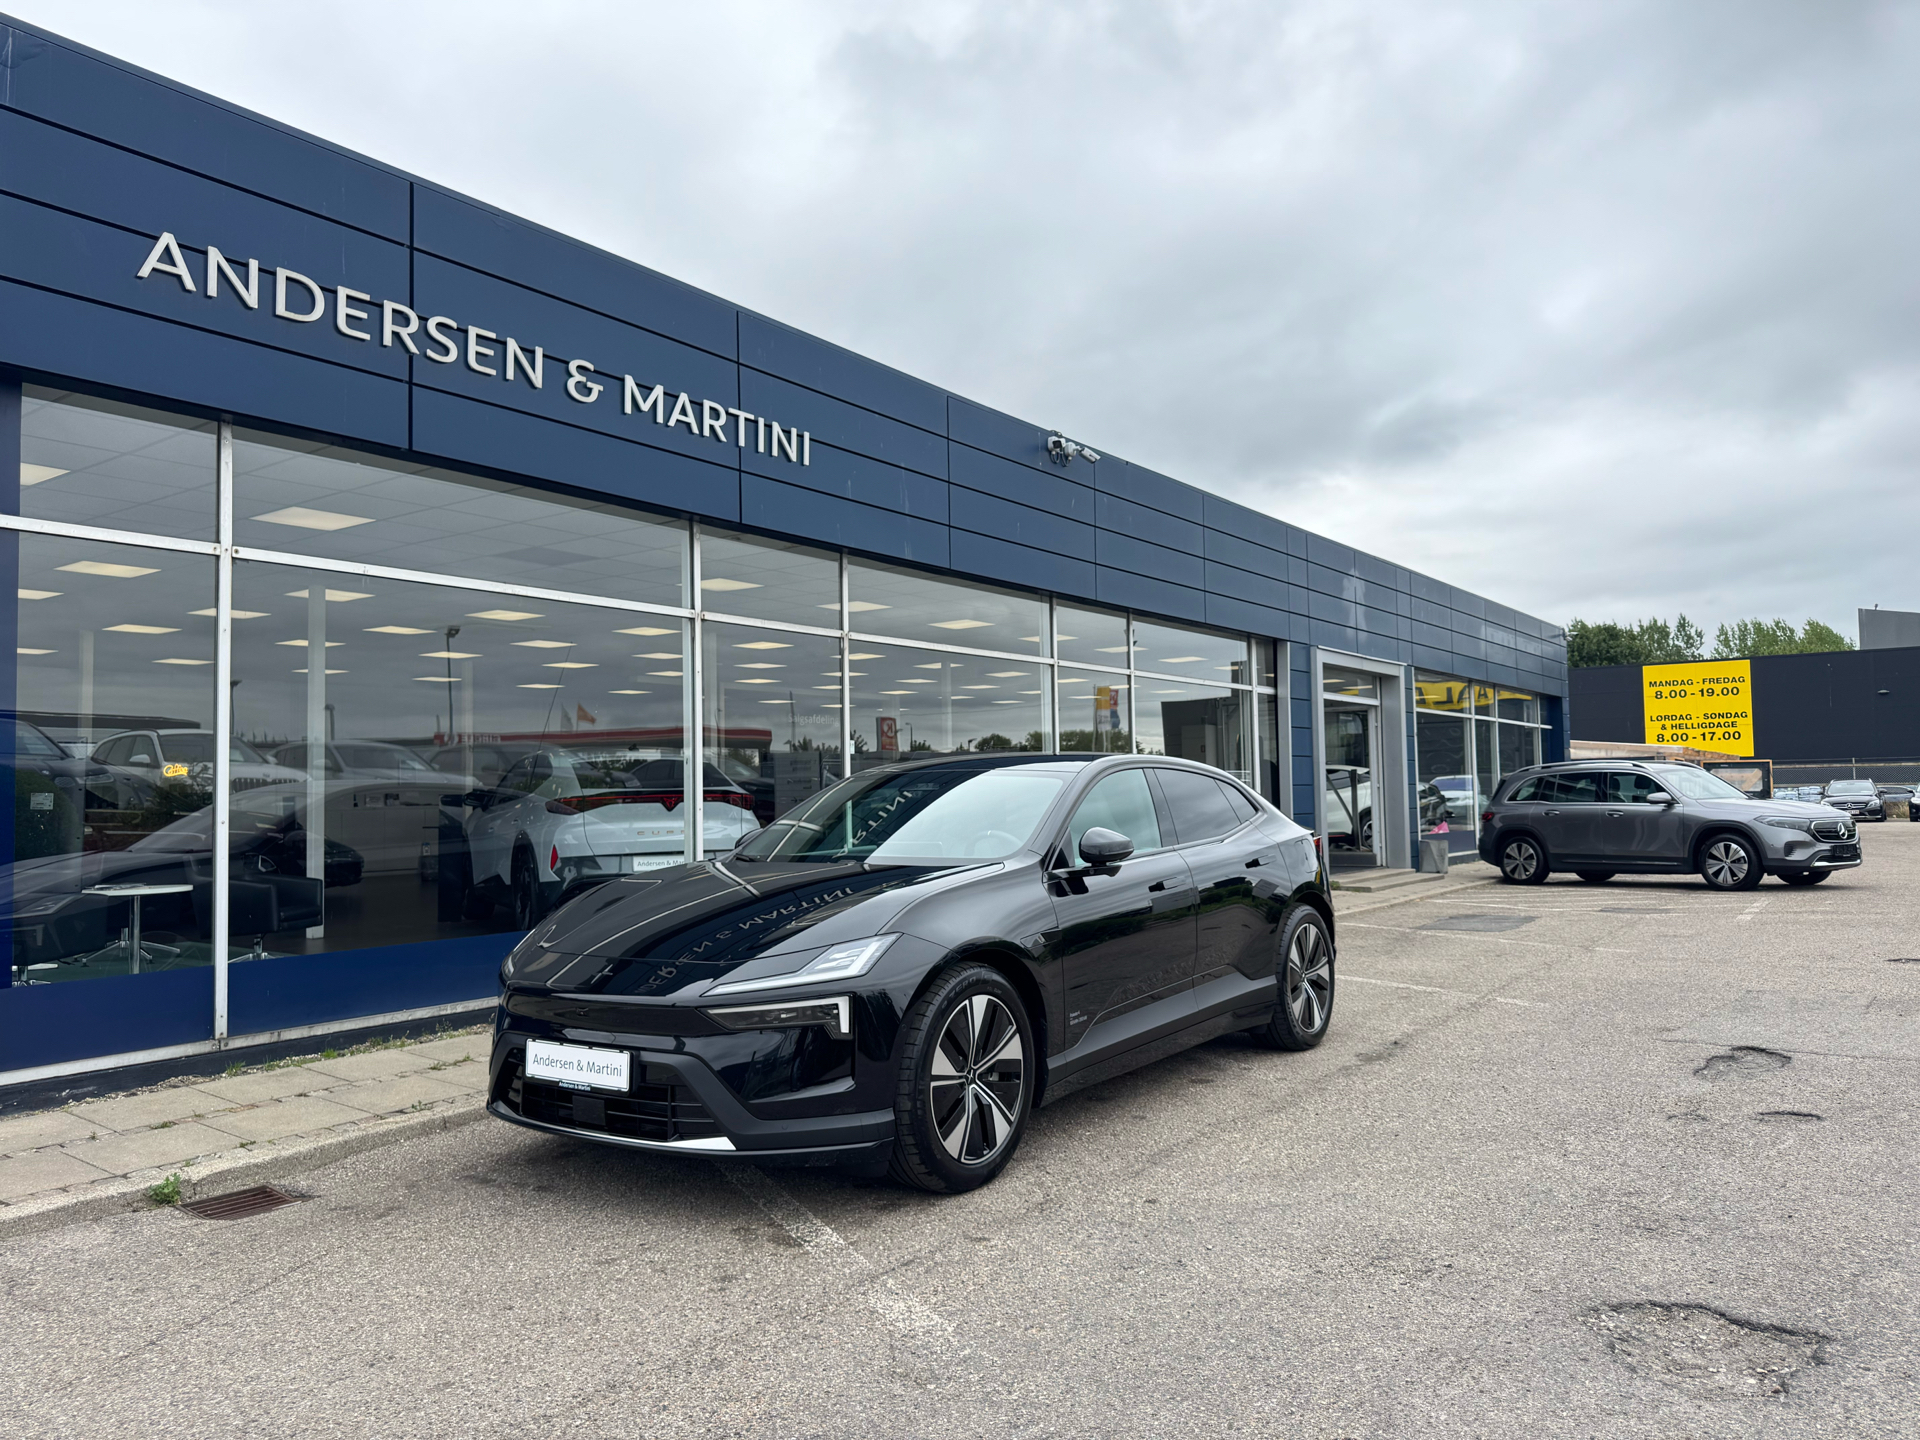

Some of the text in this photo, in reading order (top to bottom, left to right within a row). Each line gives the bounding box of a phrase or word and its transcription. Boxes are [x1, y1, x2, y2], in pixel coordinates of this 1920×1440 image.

[136, 231, 810, 466] ANDERSEN & MARTINI
[1648, 679, 1694, 688] MANDAG
[1702, 676, 1745, 685] FREDAG
[788, 713, 840, 727] Salgsafdeling
[1650, 713, 1692, 722] LØRDAG
[1703, 711, 1748, 720] SØNDAG
[1671, 721, 1738, 730] HELLIGDAGE
[532, 1053, 622, 1077] Andersen & Martini
